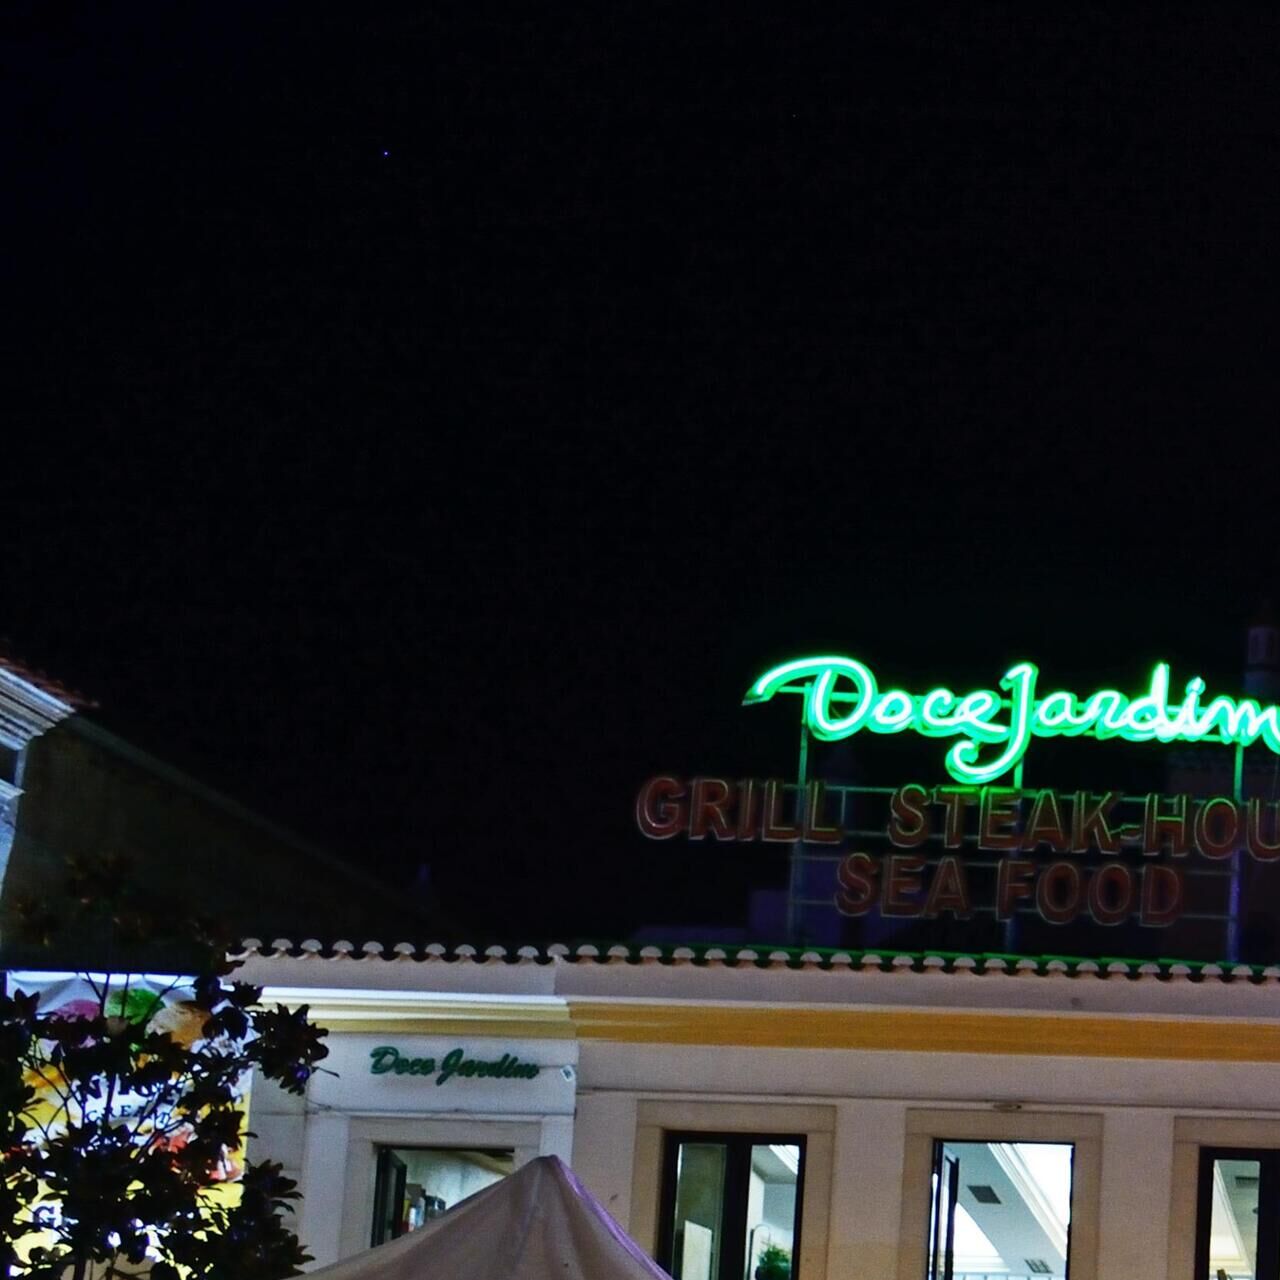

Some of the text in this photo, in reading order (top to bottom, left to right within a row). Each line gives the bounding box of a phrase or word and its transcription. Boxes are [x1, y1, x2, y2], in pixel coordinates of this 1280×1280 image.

[636, 774, 843, 843] GRILL
[834, 850, 1187, 928] SEA FOOD
